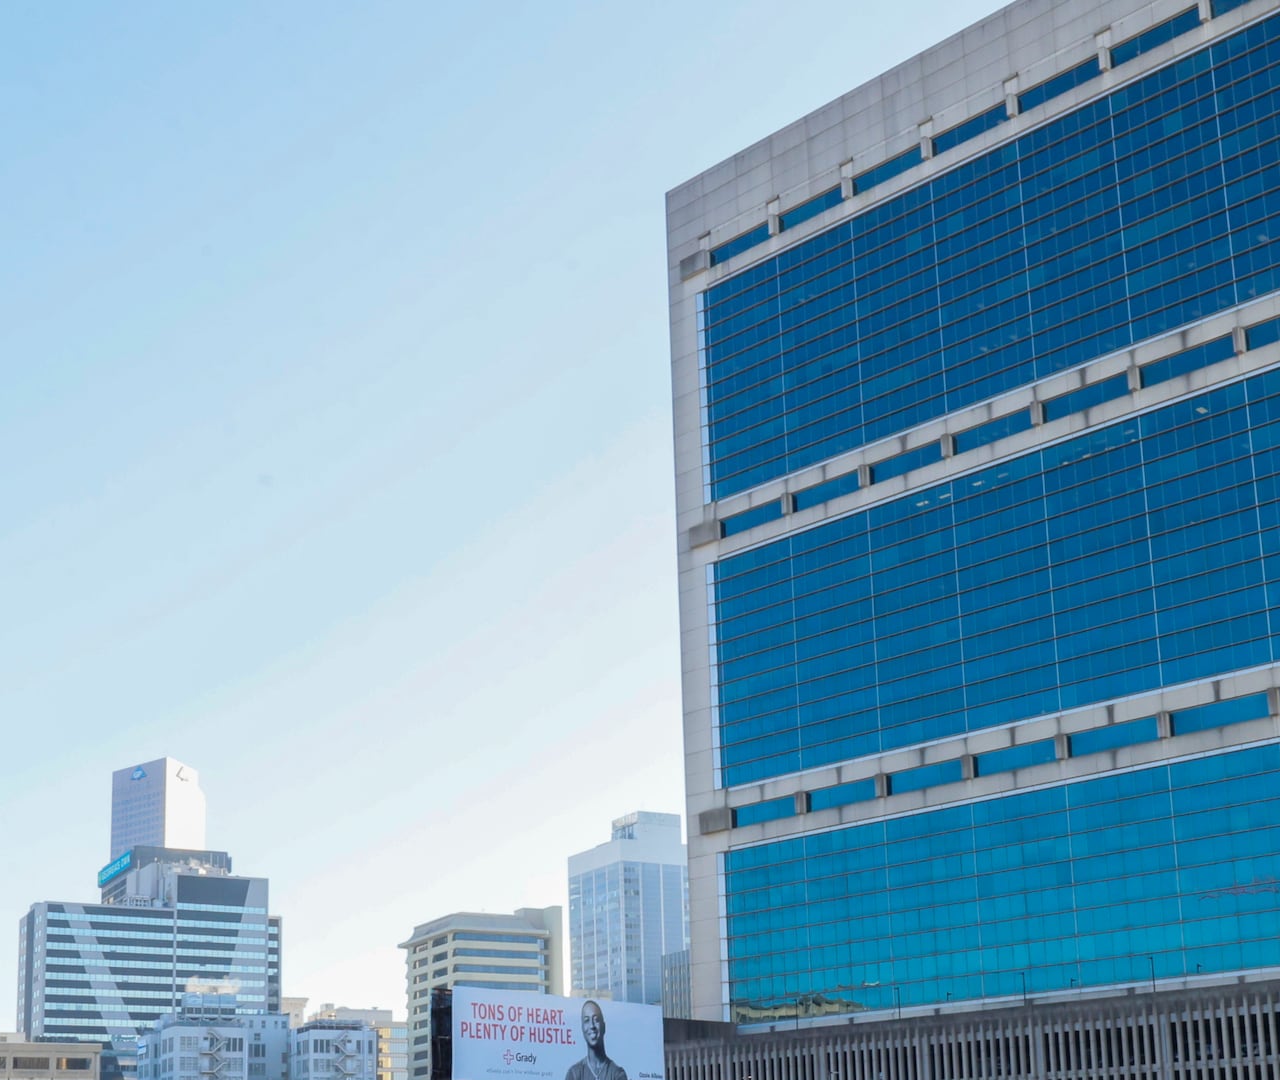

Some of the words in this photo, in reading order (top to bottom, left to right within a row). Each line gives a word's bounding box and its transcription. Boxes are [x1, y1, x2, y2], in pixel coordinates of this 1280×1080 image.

[471, 1002, 505, 1021] TONS
[508, 1006, 523, 1022] OF
[526, 1008, 566, 1026] HEART.
[460, 1021, 507, 1041] PLENTY
[510, 1025, 525, 1042] OF
[529, 1027, 576, 1045] HUSTLE.
[515, 1052, 537, 1064] Grady
